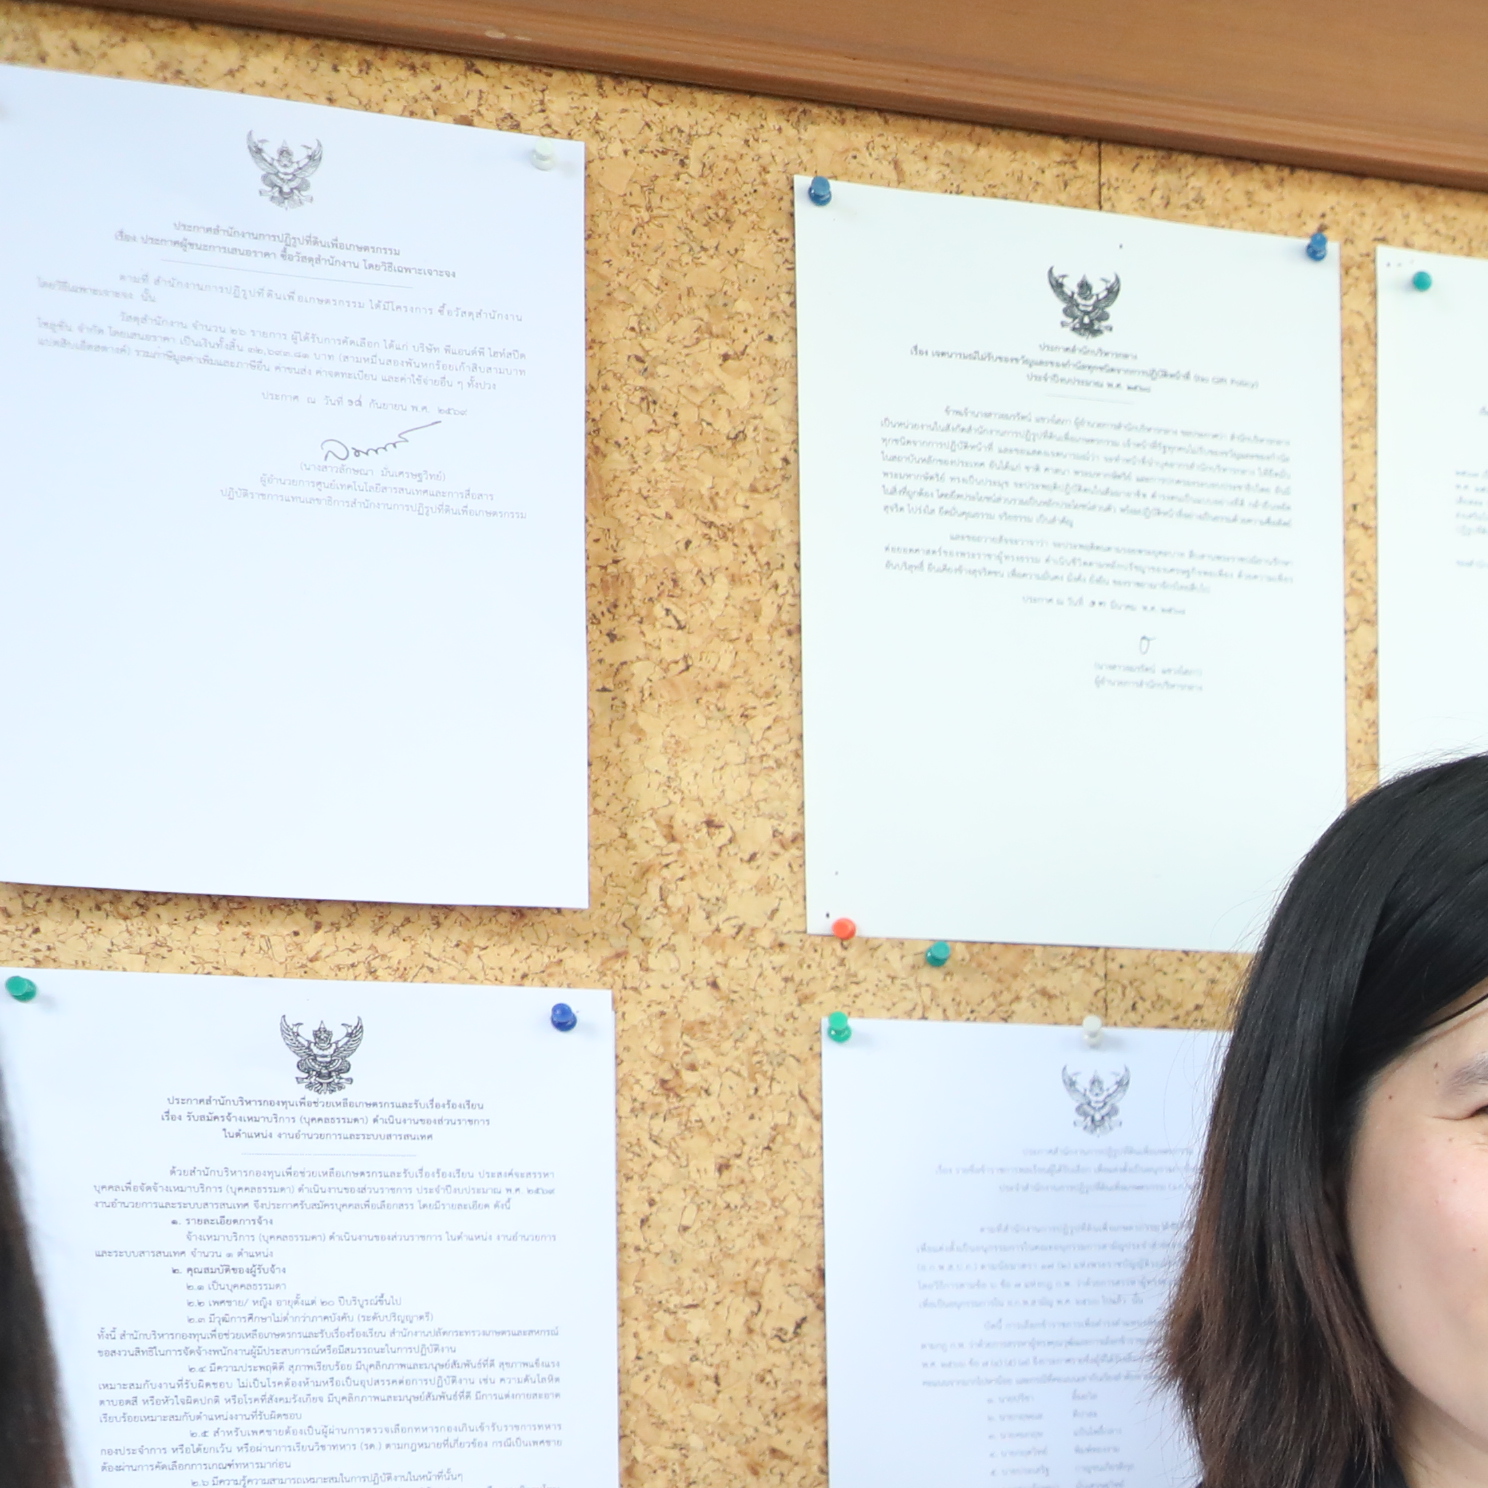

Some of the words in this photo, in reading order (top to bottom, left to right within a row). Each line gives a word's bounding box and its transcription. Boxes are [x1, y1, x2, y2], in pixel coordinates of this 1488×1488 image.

[192, 320, 226, 334] จำนวน
[230, 327, 246, 336] ๒๖
[313, 352, 335, 361] บาท
[457, 381, 463, 390] ๆ
[410, 405, 430, 413] พ.ศ.
[190, 1248, 222, 1258] จำนวน
[186, 1283, 204, 1291] ๒.๑
[187, 1299, 205, 1307] ๒.๒
[252, 1296, 272, 1309] หญิง
[187, 1316, 205, 1324] ๒.๓
[188, 1365, 206, 1373] ๒.๔
[479, 1377, 495, 1385] เช่น
[190, 1430, 209, 1438] ๒.๕
[360, 1442, 382, 1450] (รด.)
[191, 1479, 209, 1487] ๒.๖
